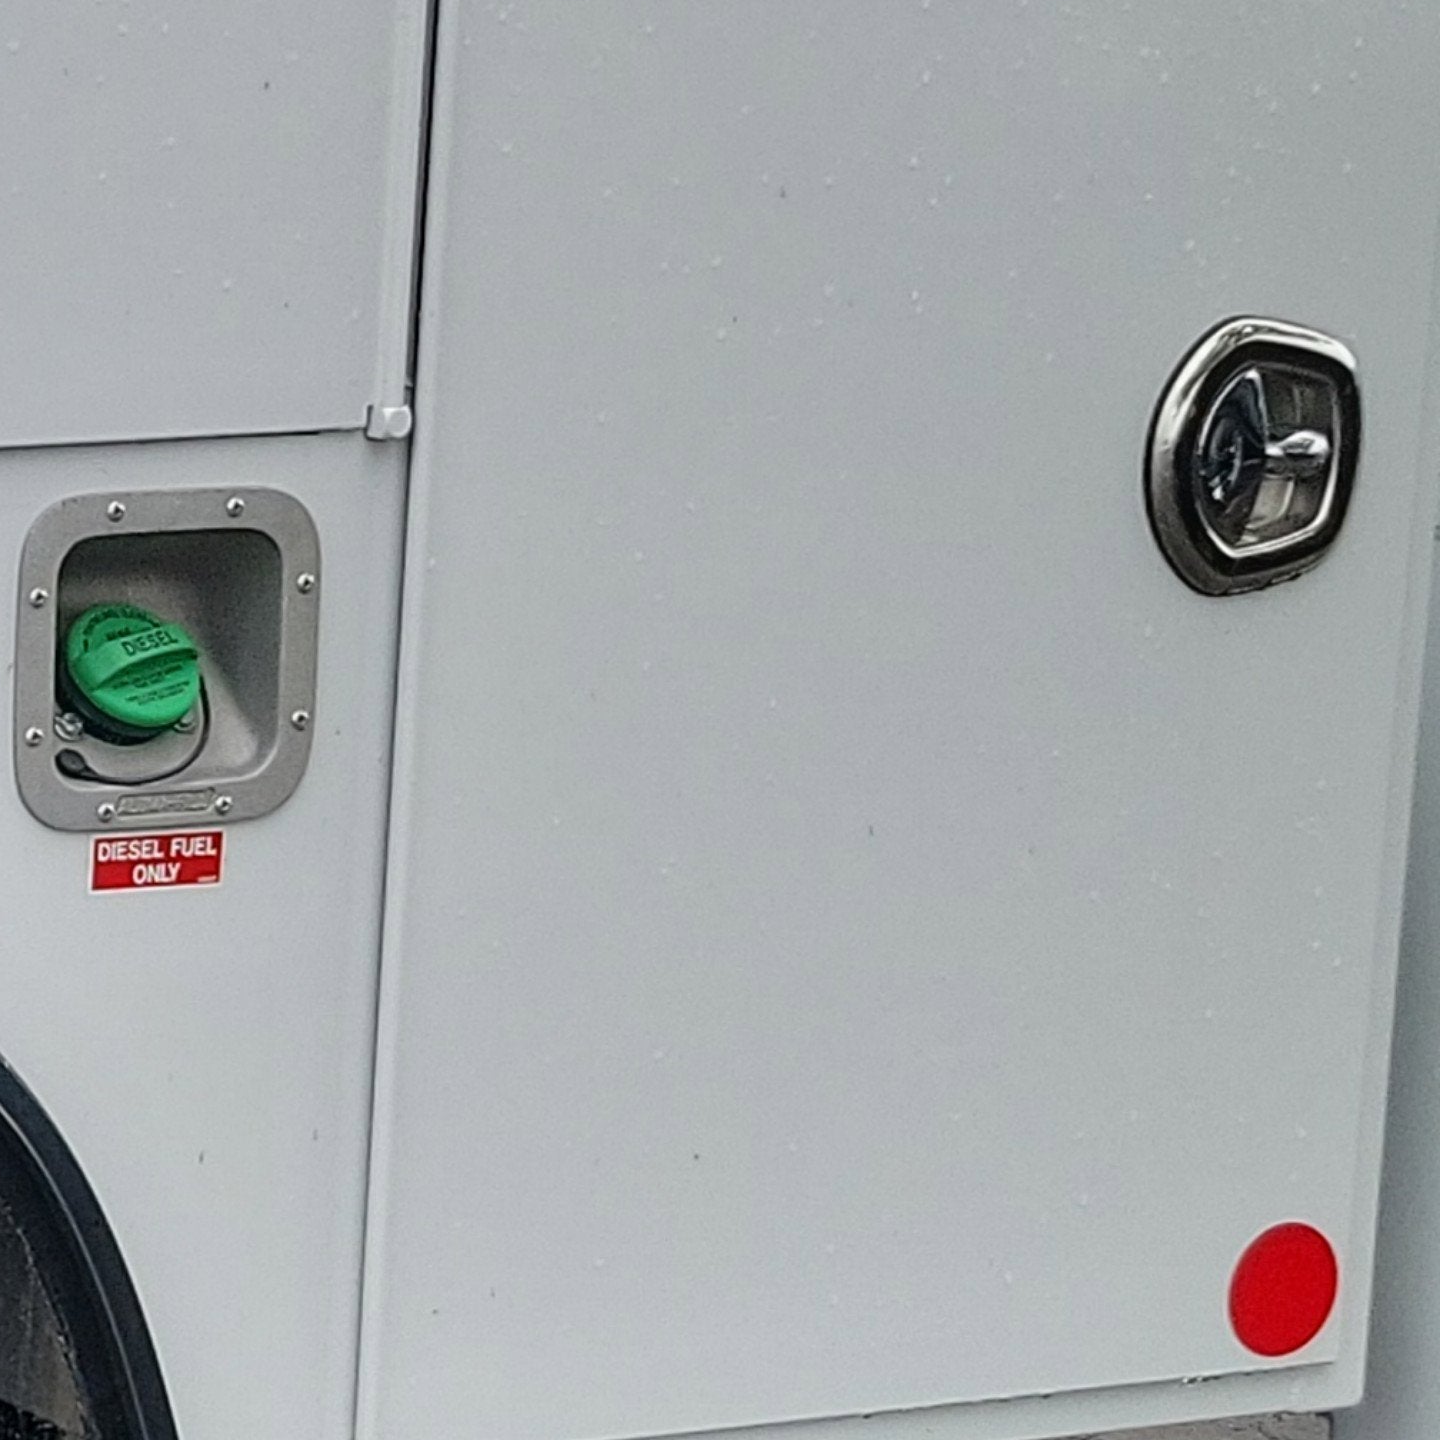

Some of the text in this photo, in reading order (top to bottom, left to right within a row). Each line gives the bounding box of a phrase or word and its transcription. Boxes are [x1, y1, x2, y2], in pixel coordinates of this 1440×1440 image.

[121, 629, 179, 658] DIESEL
[97, 836, 218, 863] DIESEL FUEL
[131, 862, 182, 885] ONLY
